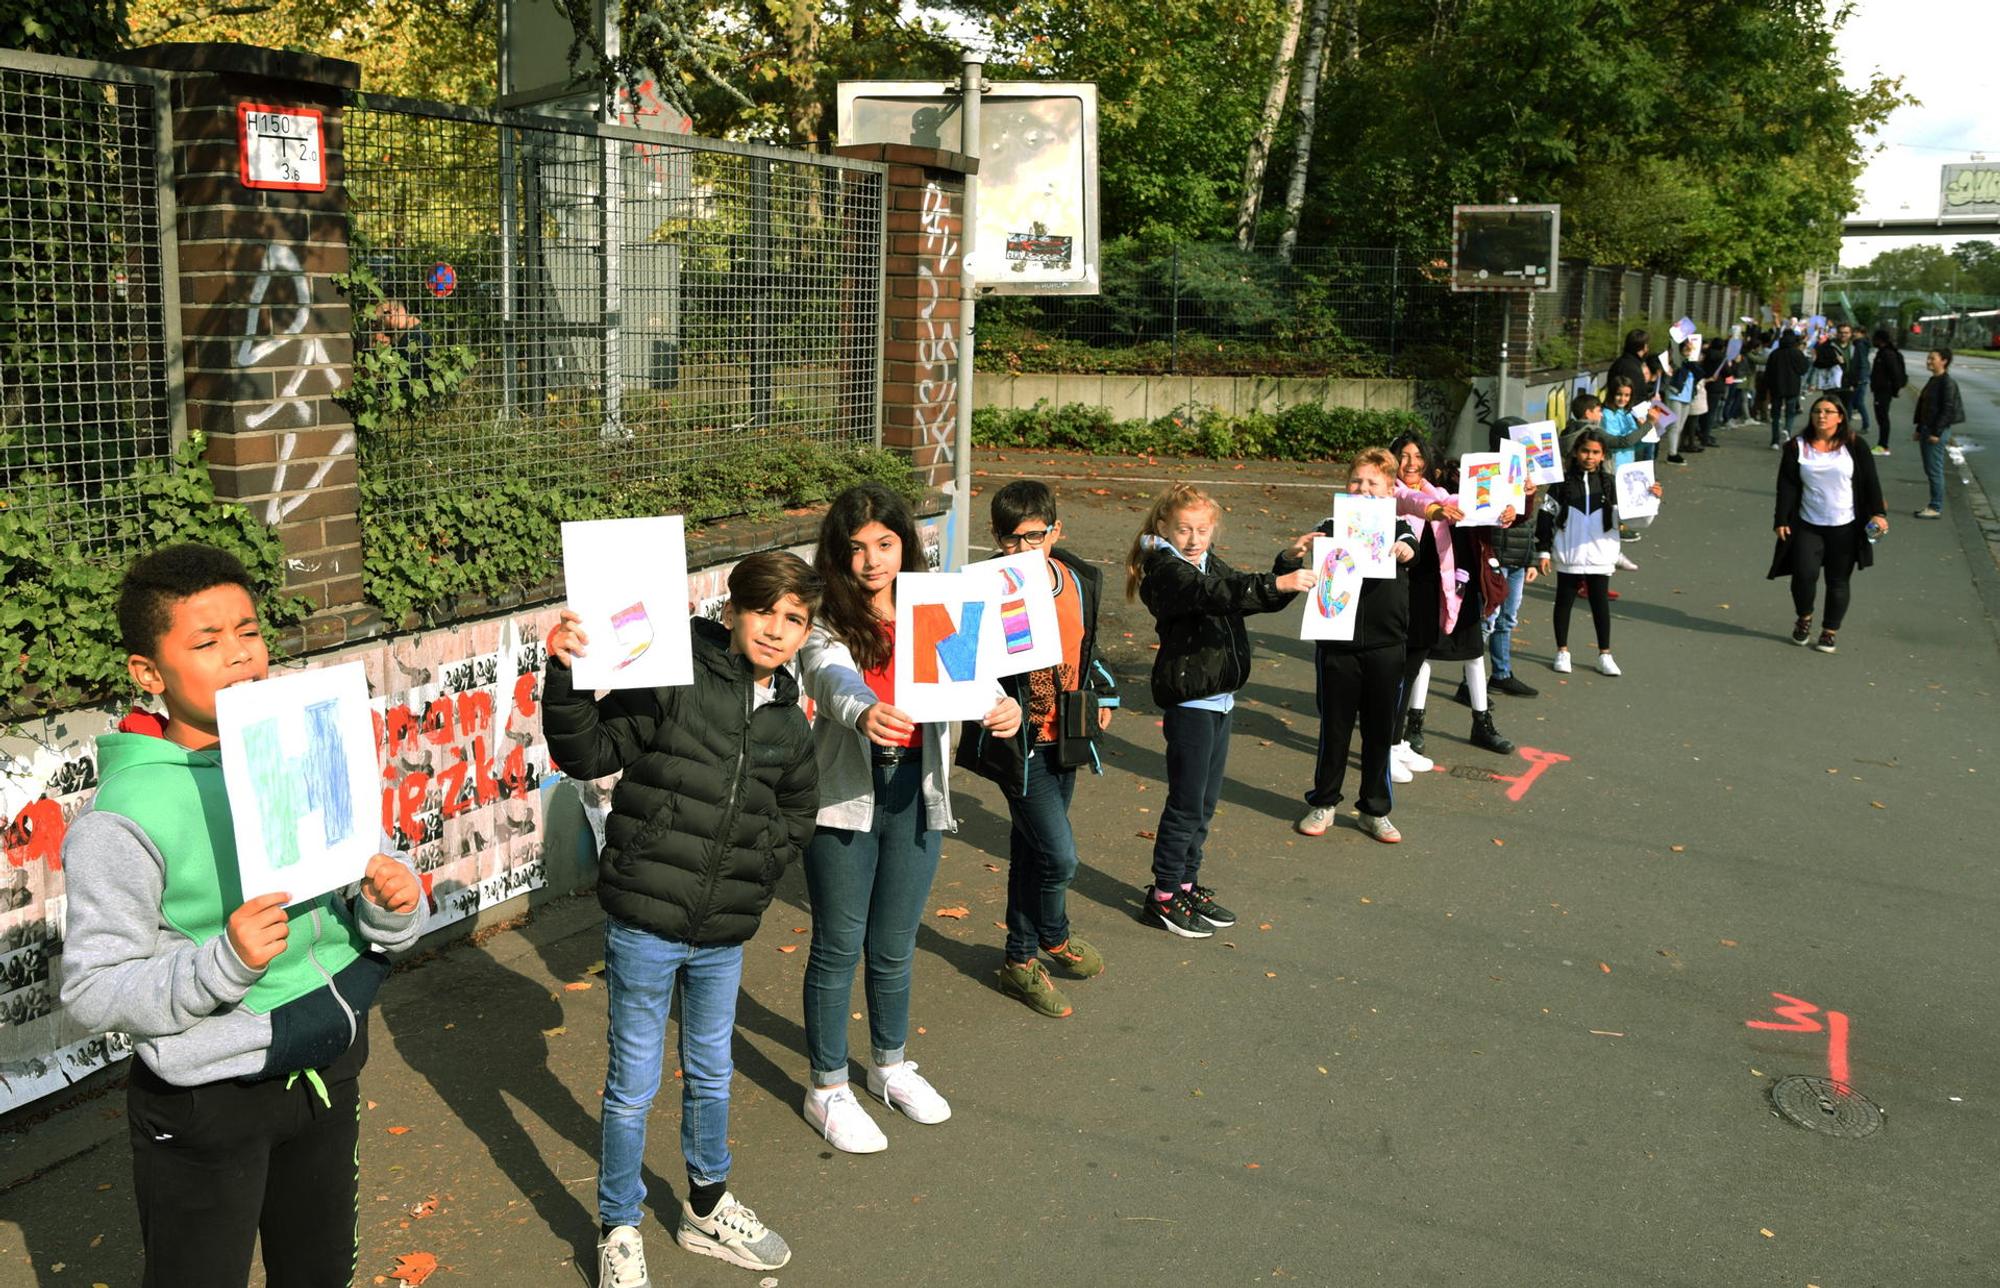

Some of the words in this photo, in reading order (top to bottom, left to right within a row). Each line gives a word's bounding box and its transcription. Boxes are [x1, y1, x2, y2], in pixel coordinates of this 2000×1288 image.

[247, 113, 290, 134] H150
[1317, 547, 1356, 619] C
[912, 601, 985, 684] N
[241, 696, 354, 870] H
